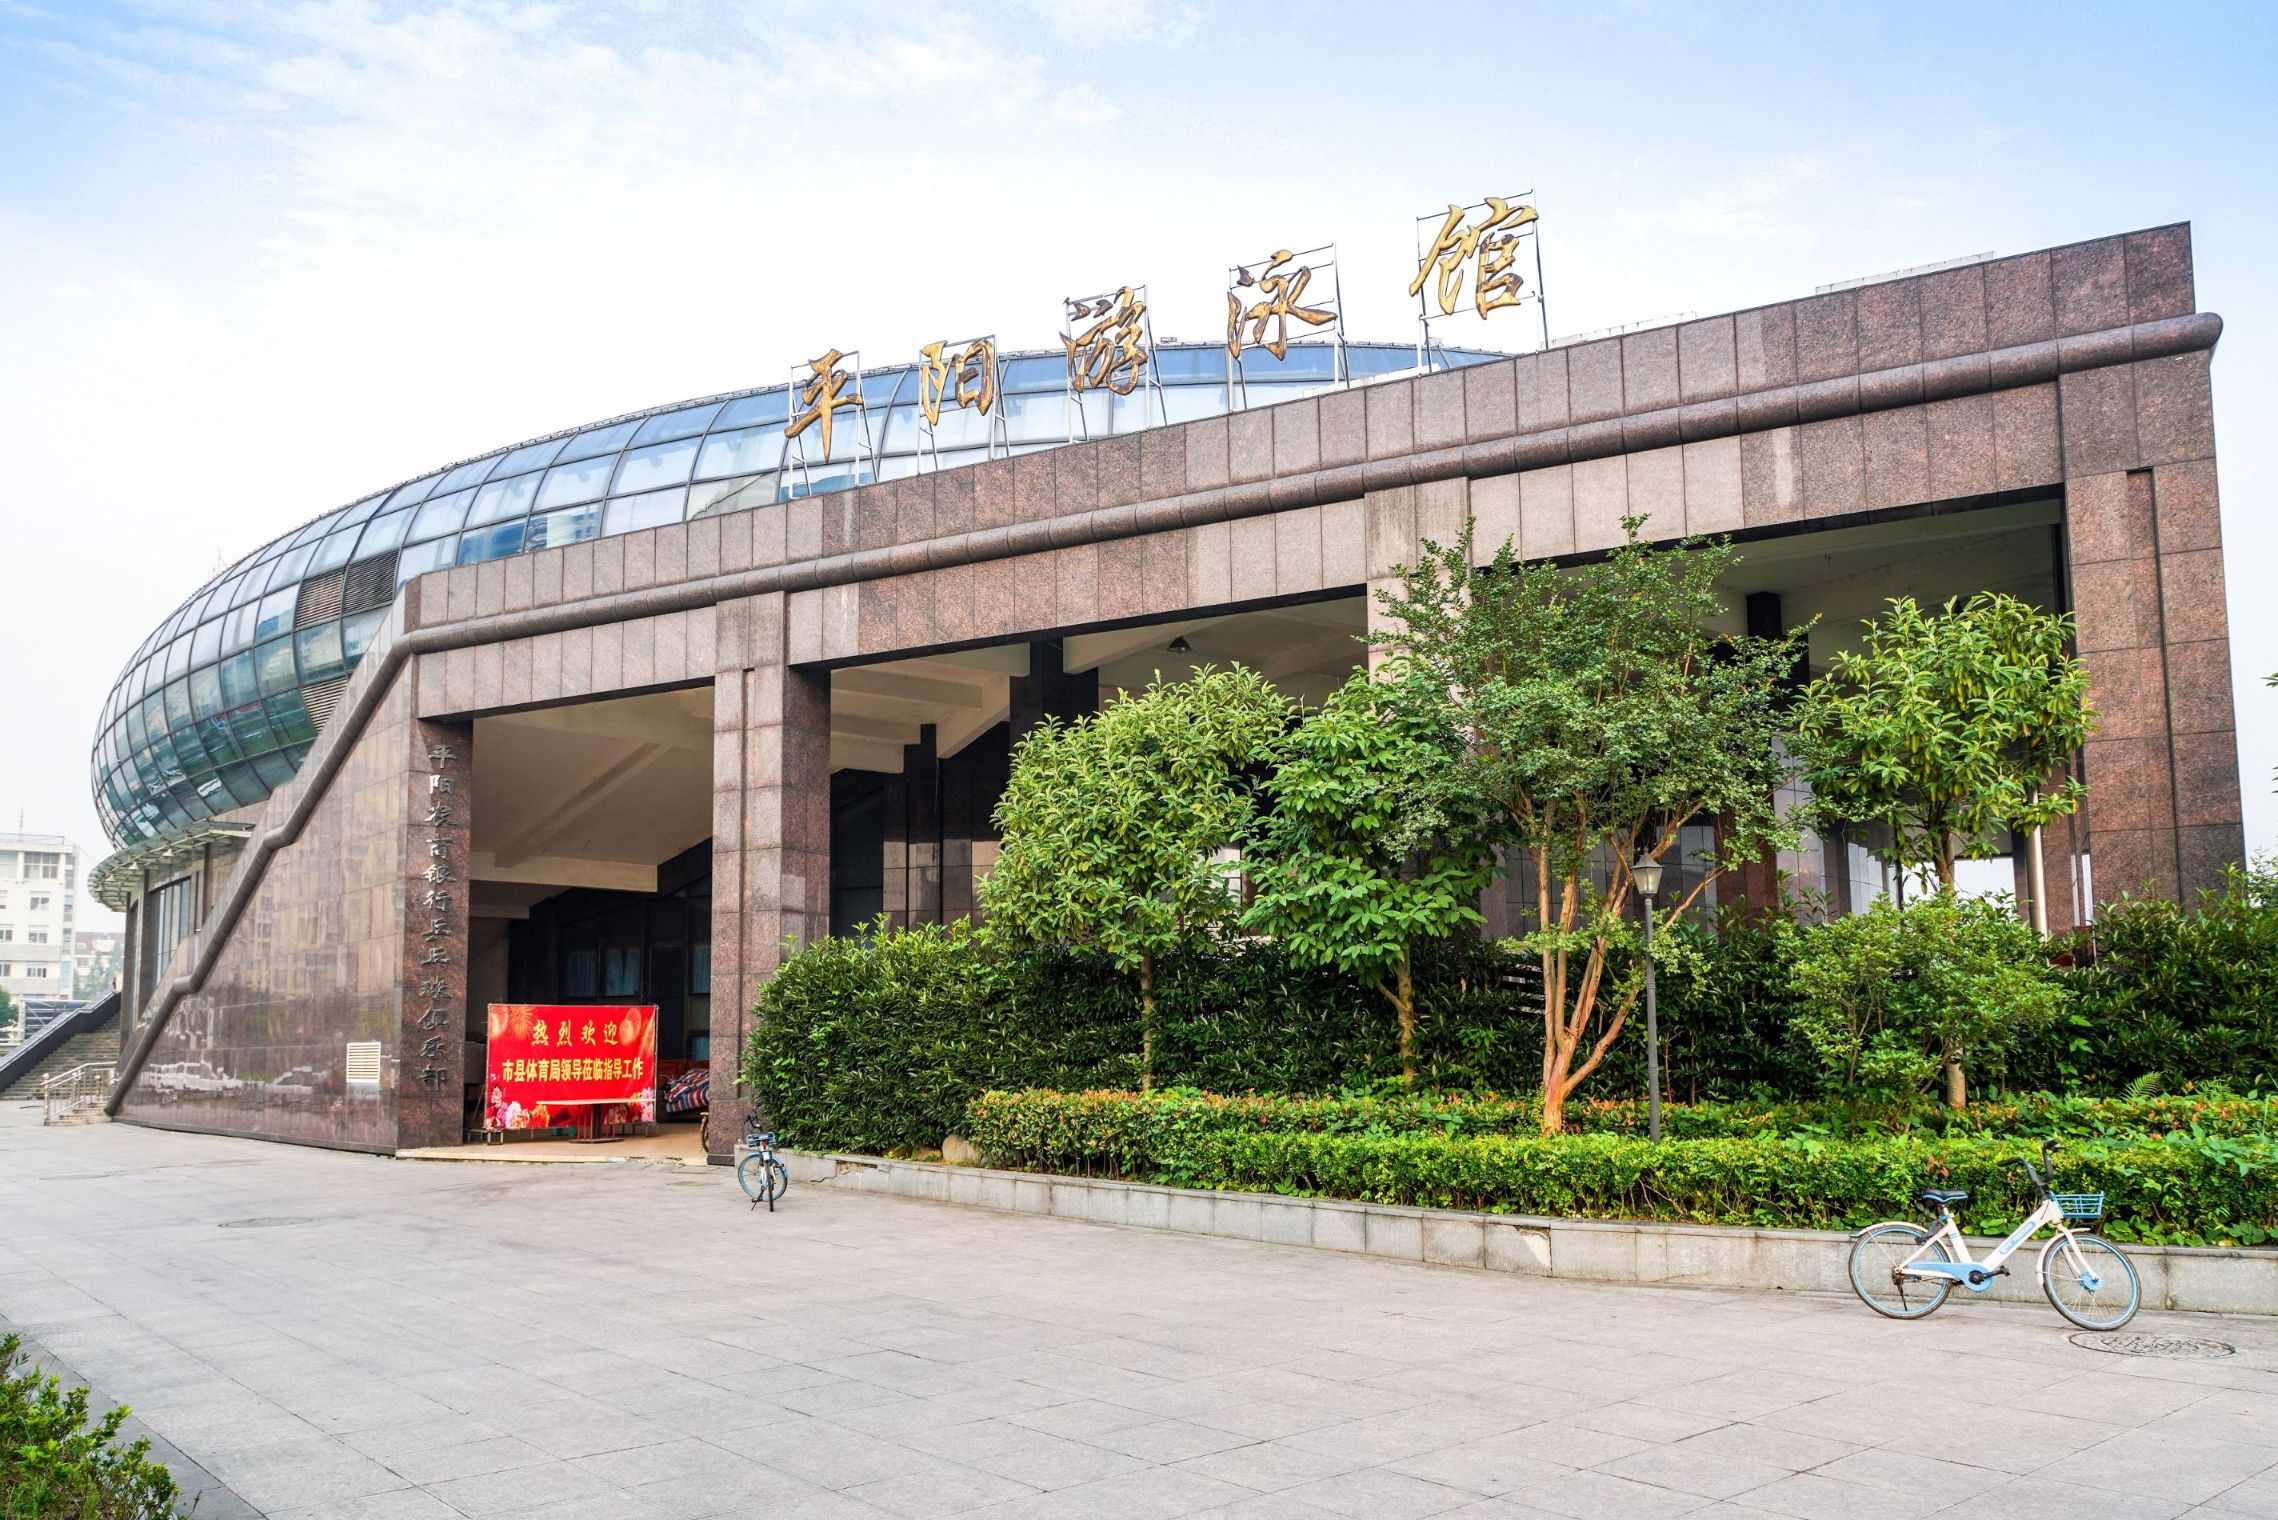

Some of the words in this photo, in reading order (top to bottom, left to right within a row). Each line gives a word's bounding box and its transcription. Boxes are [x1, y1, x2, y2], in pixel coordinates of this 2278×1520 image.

[785, 197, 1539, 463] 平阳游泳馆
[531, 1019, 618, 1047] 热烈欢迎
[502, 1058, 644, 1083] 市县体育局领导莅临指导工作
